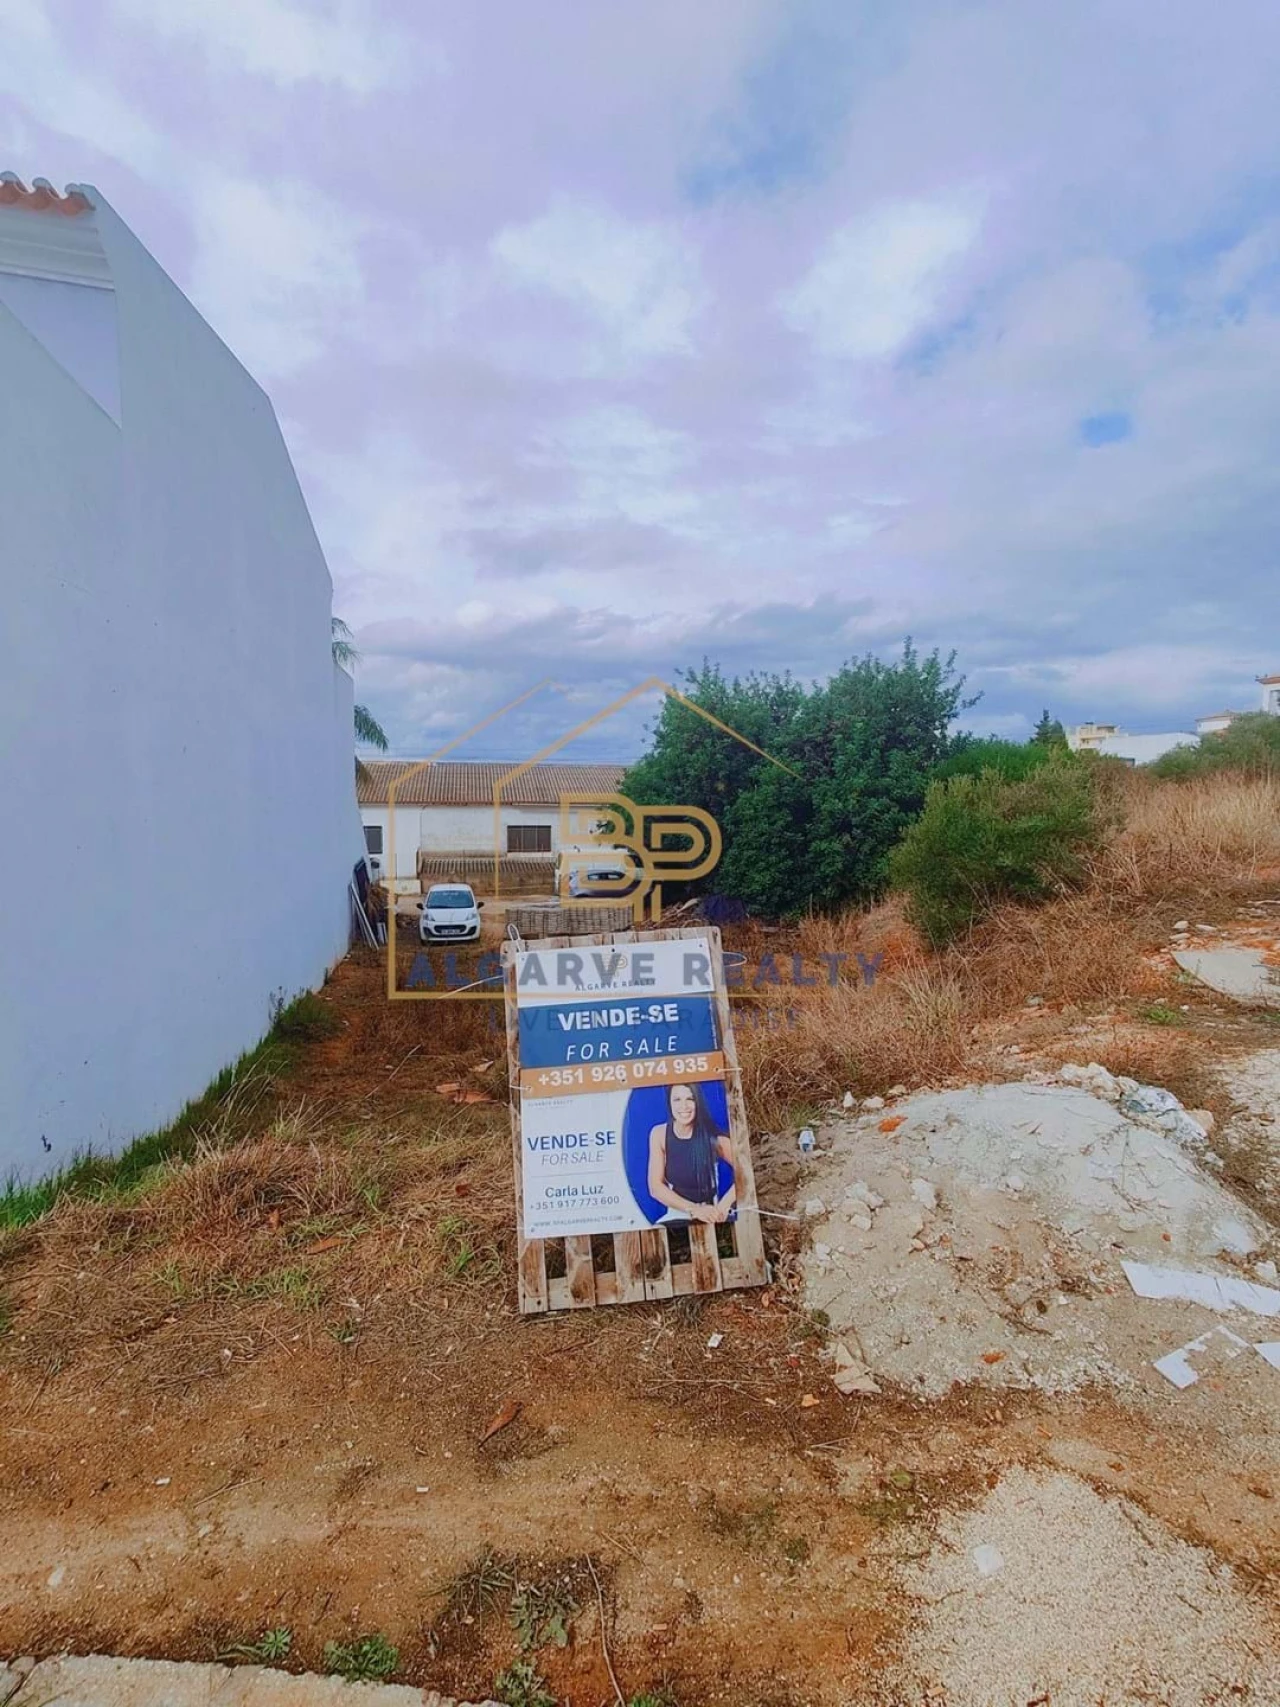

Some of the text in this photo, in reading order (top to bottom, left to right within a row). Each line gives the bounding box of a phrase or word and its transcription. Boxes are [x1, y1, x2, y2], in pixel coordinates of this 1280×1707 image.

[574, 981, 618, 992] ALGARVE
[557, 1003, 680, 1031] VENDE-SE
[566, 1036, 679, 1061] FOR SALE
[538, 1057, 709, 1087] +351 926 074 935
[527, 1131, 617, 1151] VENDE-SE
[541, 1150, 605, 1166] FOR SALE
[544, 1183, 605, 1198] Carla Luz
[557, 1199, 576, 1209] 917
[578, 1197, 598, 1207] 773
[600, 1195, 620, 1205] 600
